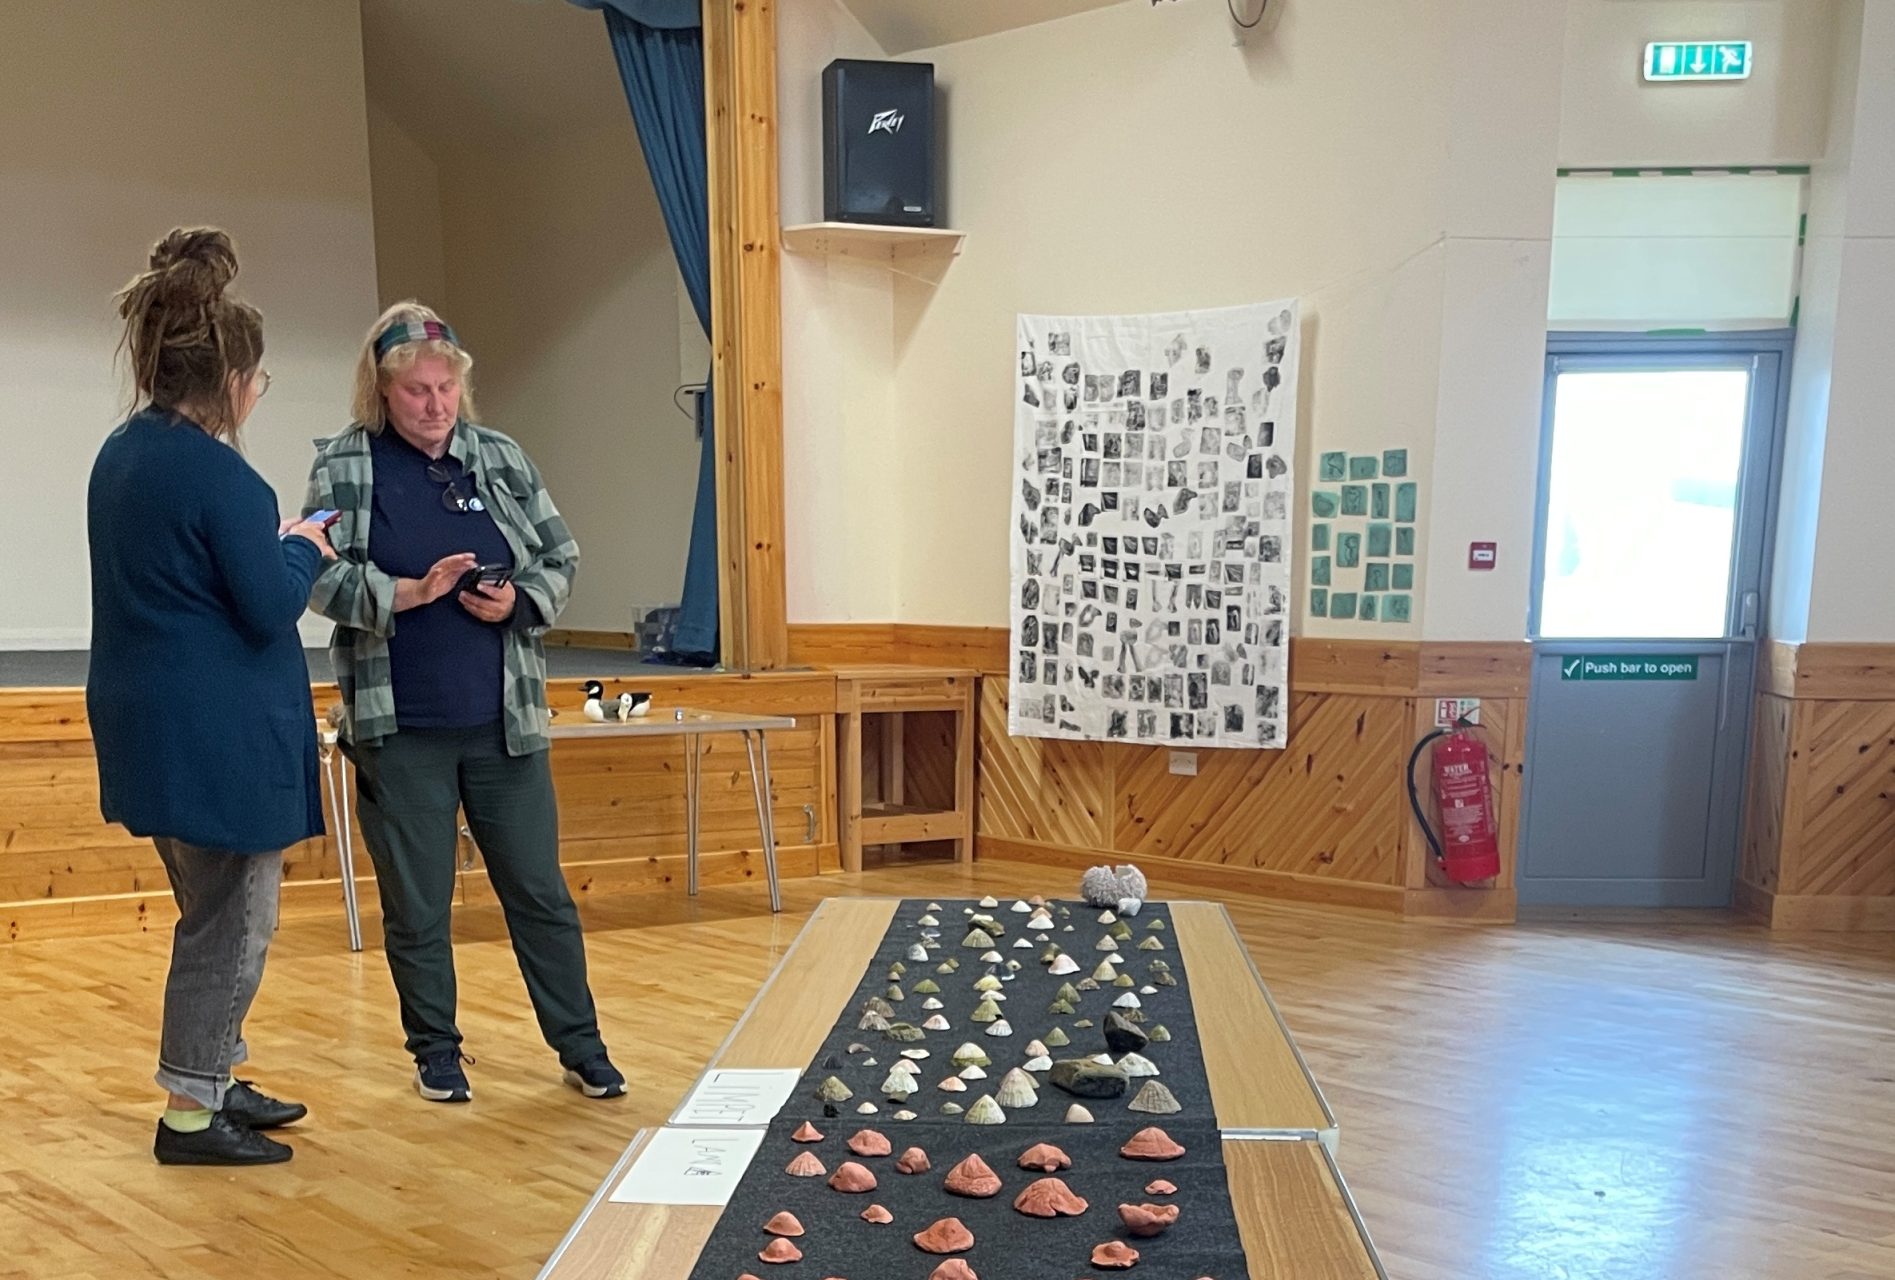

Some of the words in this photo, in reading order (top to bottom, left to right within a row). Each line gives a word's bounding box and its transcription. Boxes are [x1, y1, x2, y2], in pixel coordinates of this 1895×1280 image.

[1584, 661, 1618, 674] Push
[1620, 662, 1641, 674] bar
[1644, 662, 1658, 674] to
[1660, 663, 1692, 677] open
